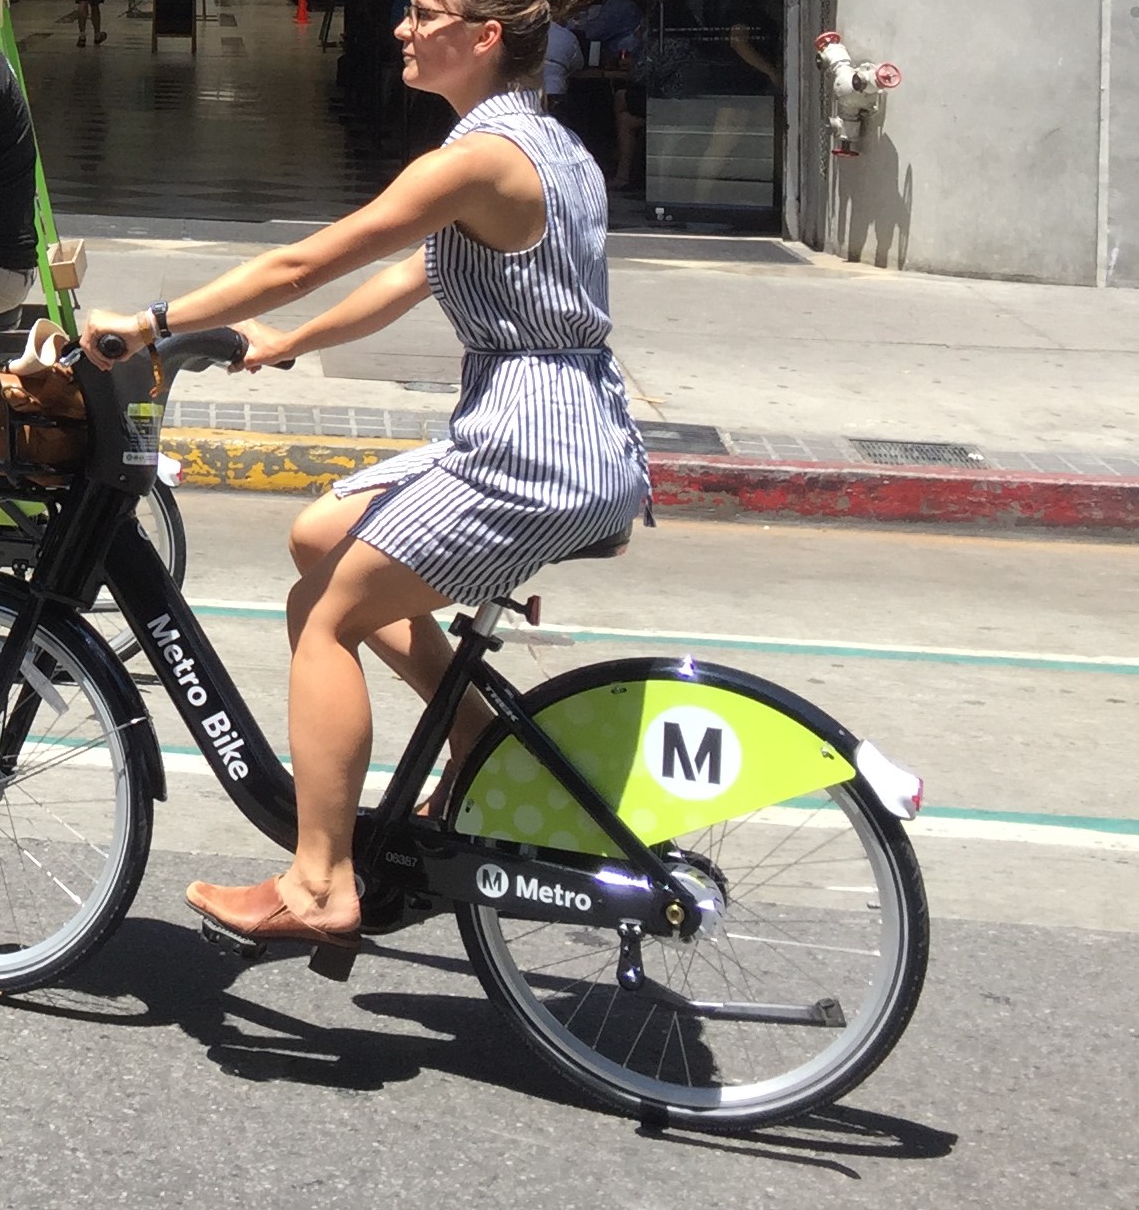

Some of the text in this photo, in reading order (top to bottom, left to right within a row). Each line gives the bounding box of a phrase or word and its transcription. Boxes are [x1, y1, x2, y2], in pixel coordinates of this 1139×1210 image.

[147, 612, 250, 781] Metro Bike
[662, 721, 723, 785] M
[516, 875, 592, 911] Metro
